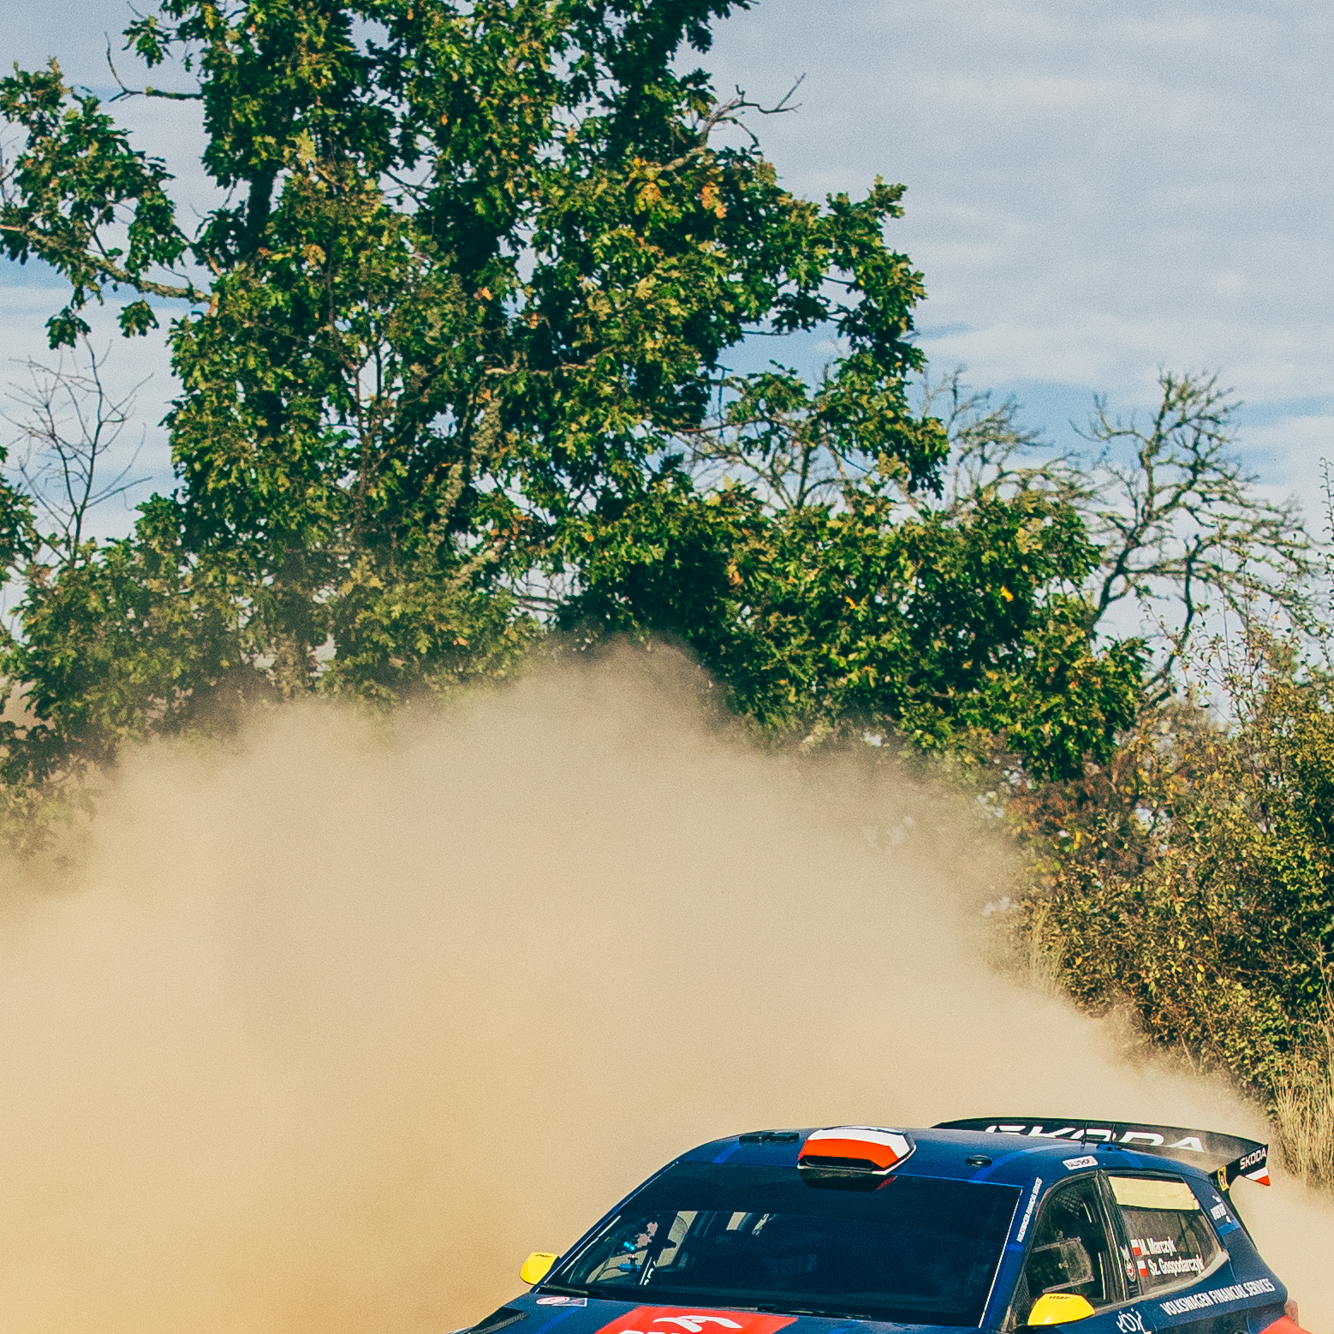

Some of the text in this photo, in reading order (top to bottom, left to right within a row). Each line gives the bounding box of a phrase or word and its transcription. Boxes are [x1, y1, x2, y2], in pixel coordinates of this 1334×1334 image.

[1159, 1278, 1276, 1316] VOLKSWAGEN FINANCIAL SERVICES
